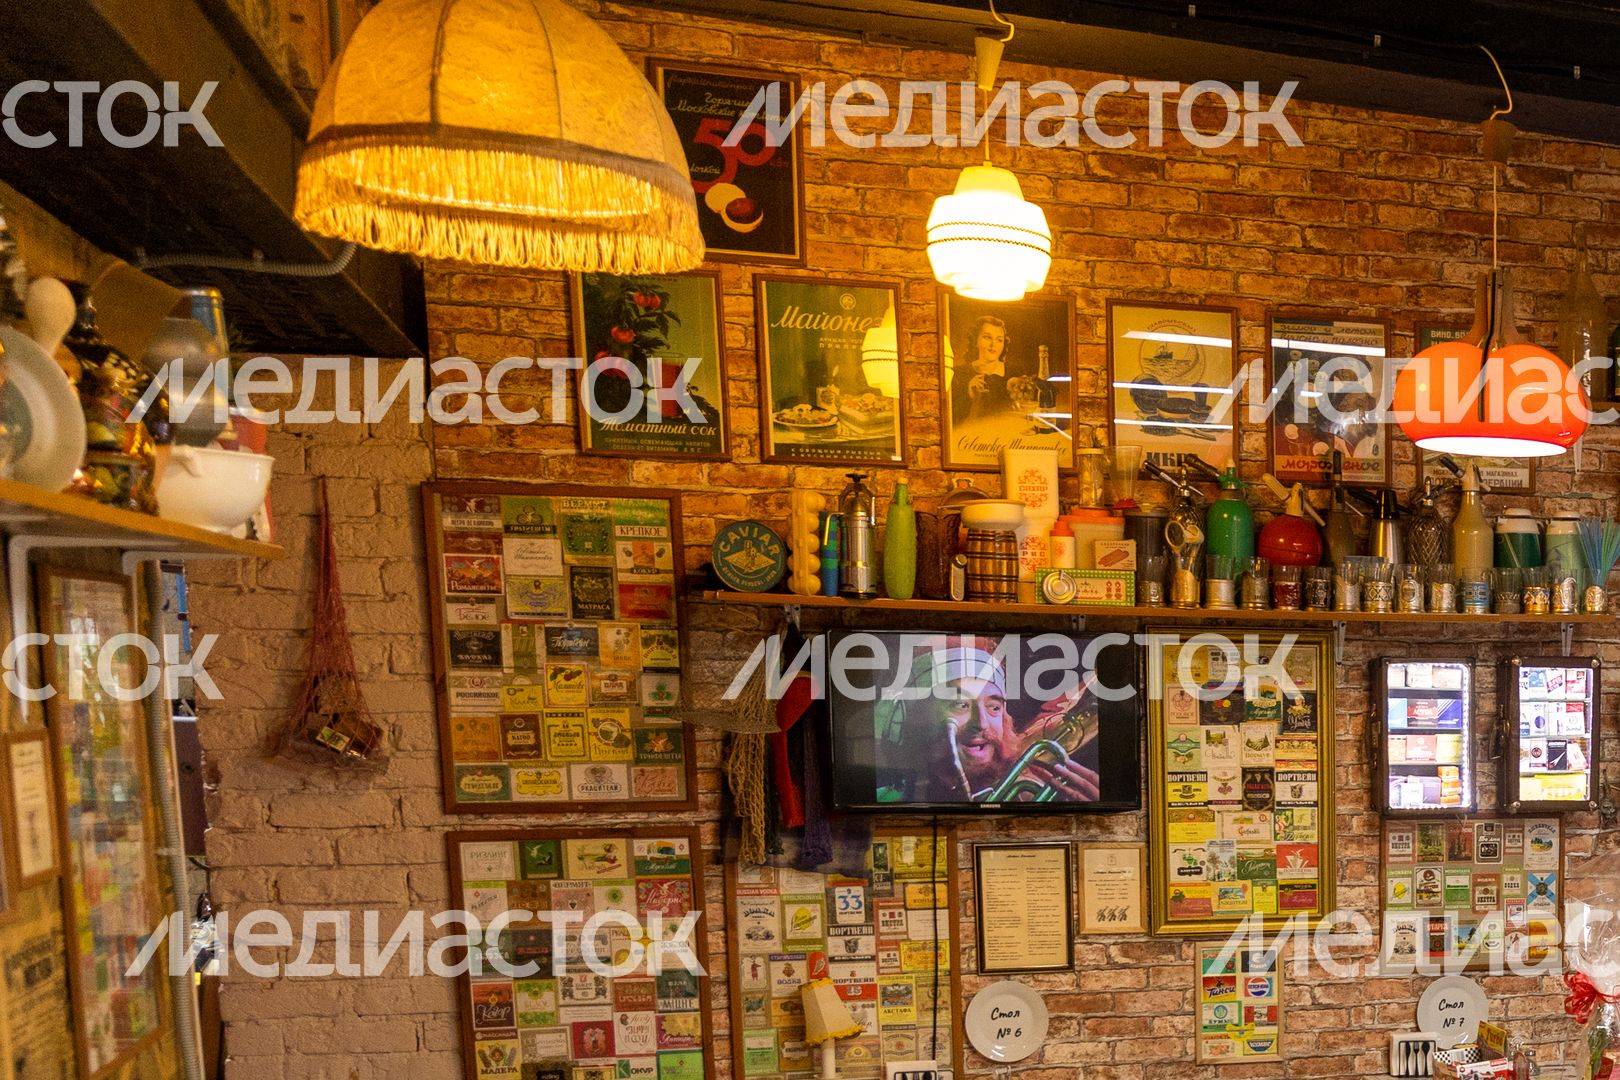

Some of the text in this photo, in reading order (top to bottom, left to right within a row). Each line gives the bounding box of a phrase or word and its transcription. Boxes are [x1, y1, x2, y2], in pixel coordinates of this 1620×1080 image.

[599, 415, 716, 437] Томатный сок
[620, 526, 663, 536] КРЕПКОЕ
[720, 520, 781, 558] CAVIAR
[838, 894, 863, 911] 33
[1438, 998, 1465, 1012] Стол
[991, 1007, 1021, 1021] Стол
[1459, 1017, 1465, 1028] 7
[1014, 1028, 1022, 1038] 6
[480, 1067, 518, 1075] МАДЕРА
